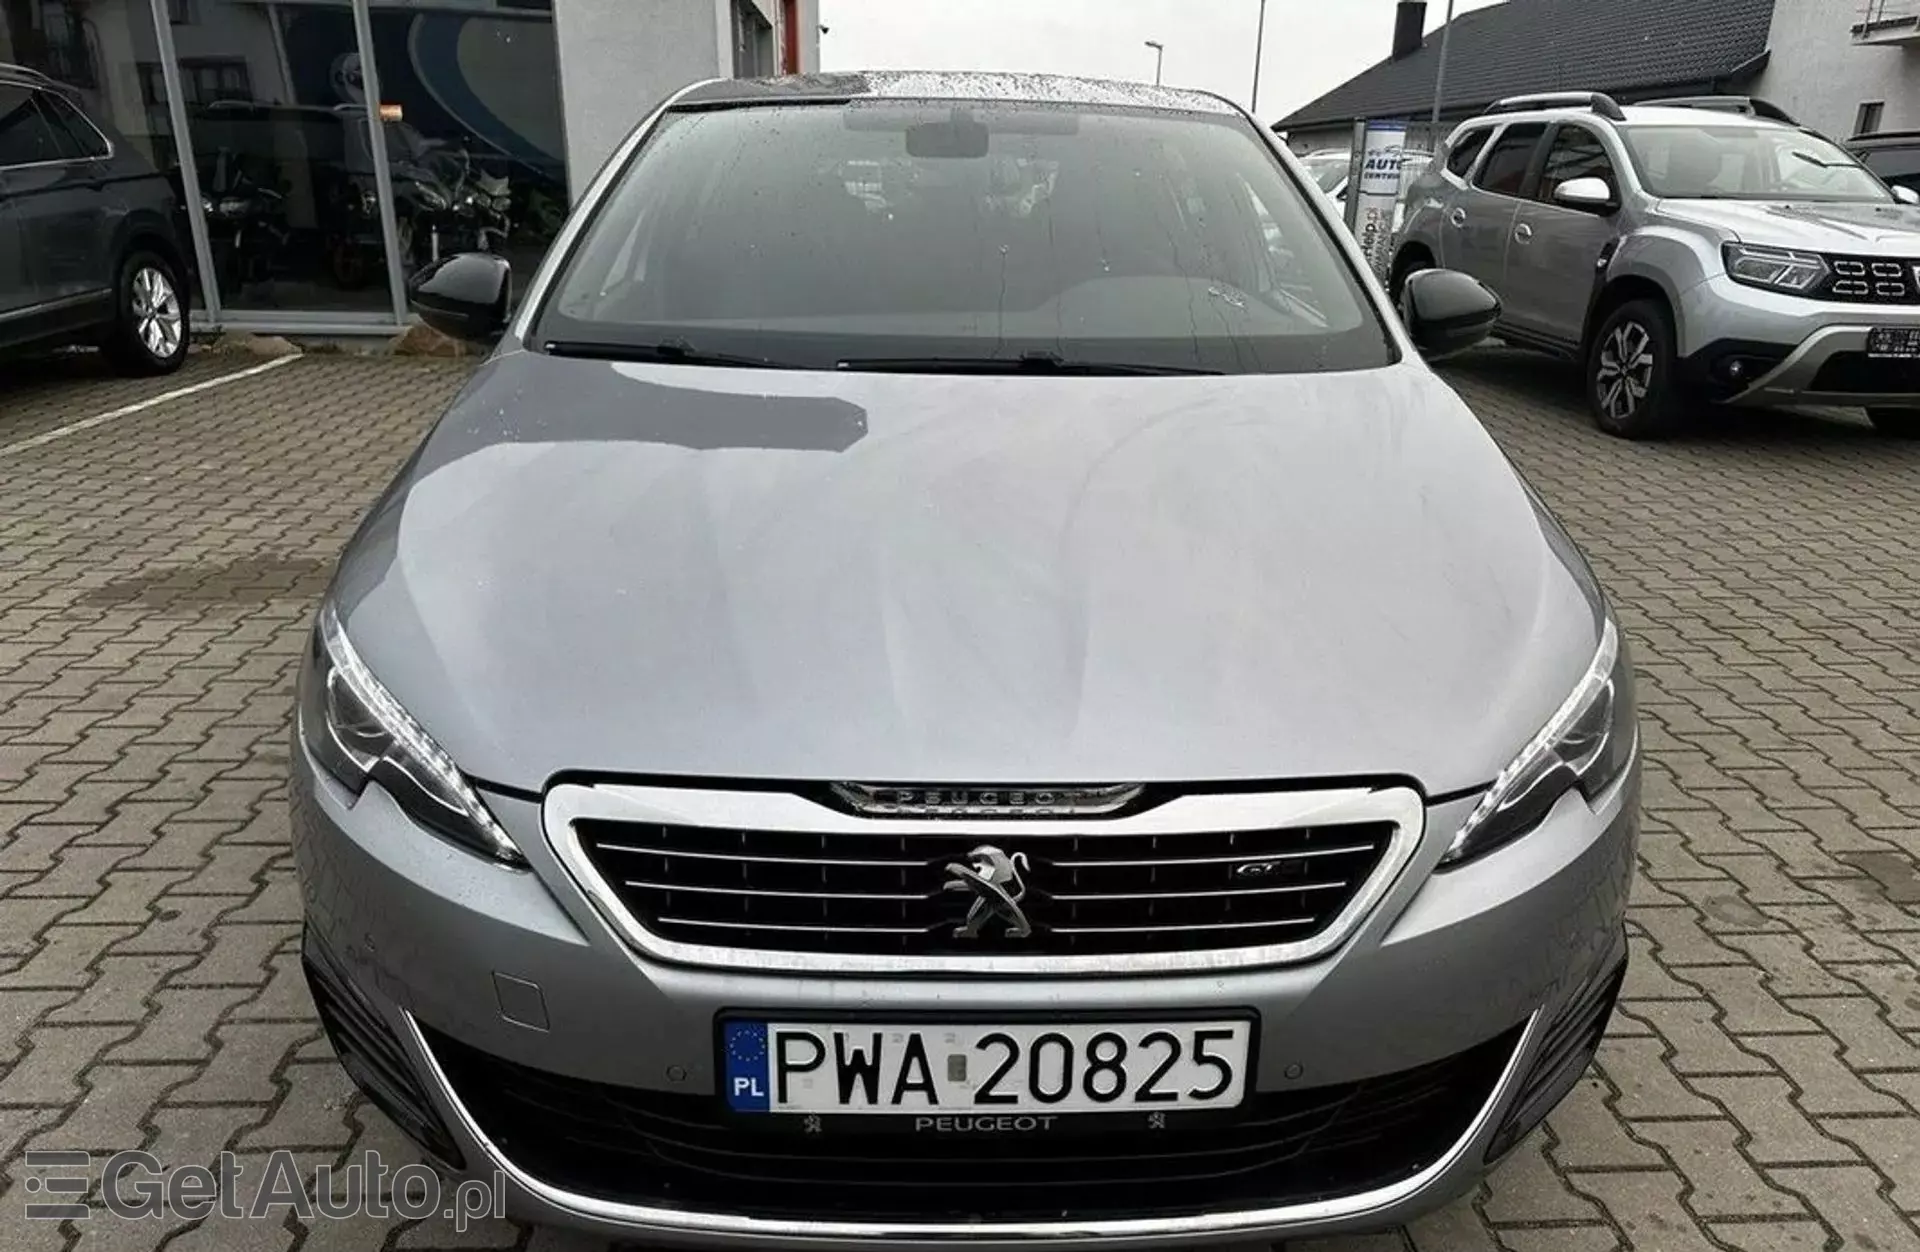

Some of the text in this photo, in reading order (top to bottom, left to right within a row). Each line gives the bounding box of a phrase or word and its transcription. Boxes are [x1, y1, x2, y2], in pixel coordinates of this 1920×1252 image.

[775, 1029, 1234, 1105] PWA 20825
[734, 1077, 764, 1097] PL
[915, 1116, 1058, 1132] PEUGEOT
